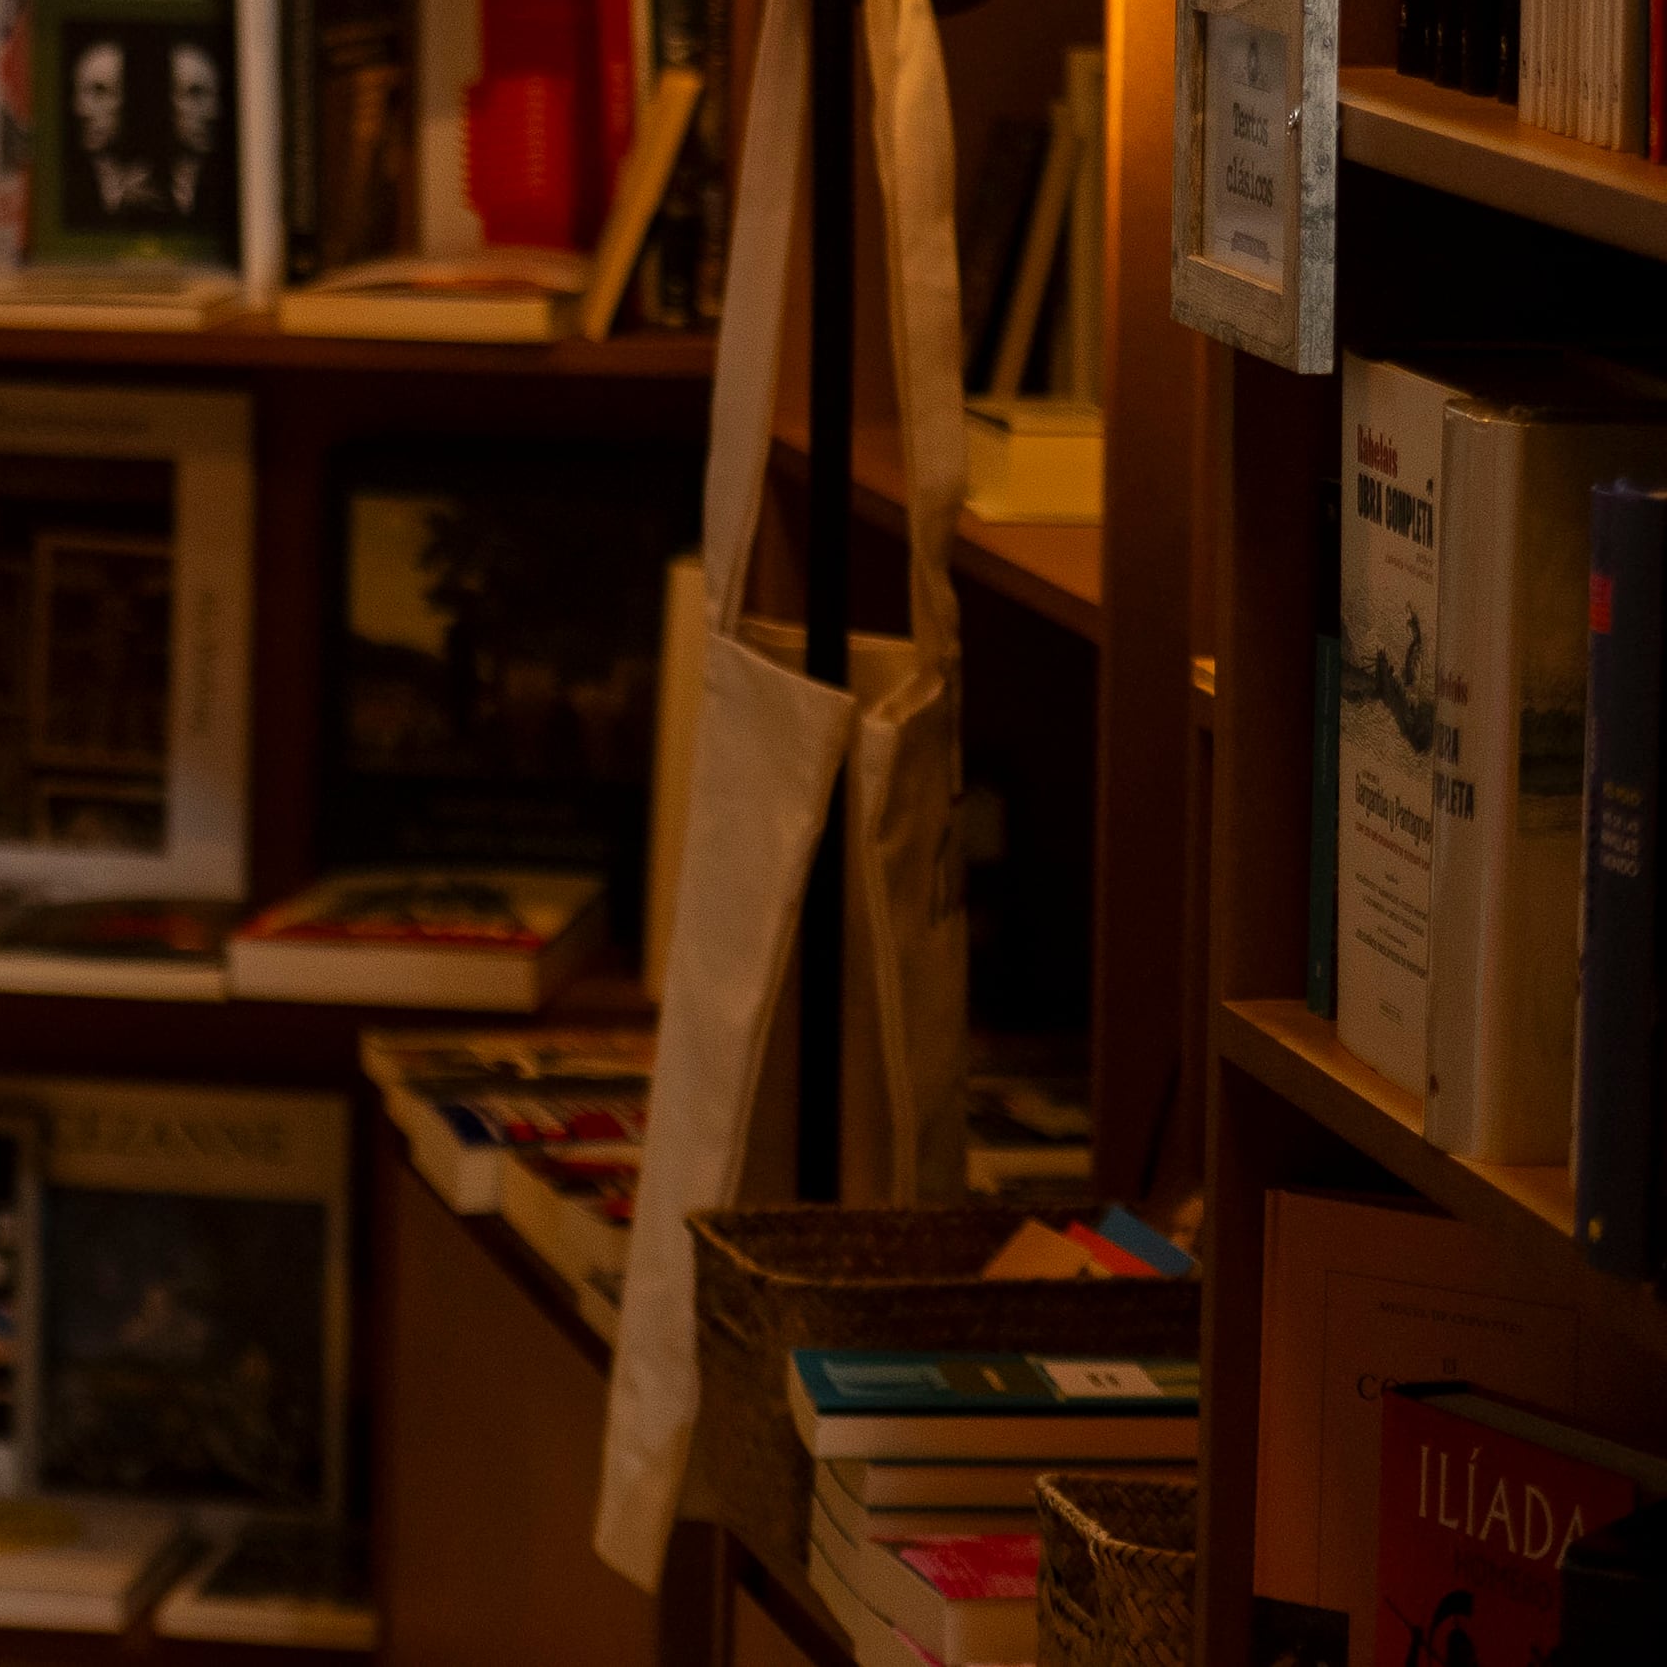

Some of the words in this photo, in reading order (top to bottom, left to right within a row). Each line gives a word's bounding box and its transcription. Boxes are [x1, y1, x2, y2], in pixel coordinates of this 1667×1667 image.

[1357, 423, 1398, 479] Rabelais
[1357, 472, 1382, 527] OBRA
[1418, 1444, 1586, 1571] ILÍADA
